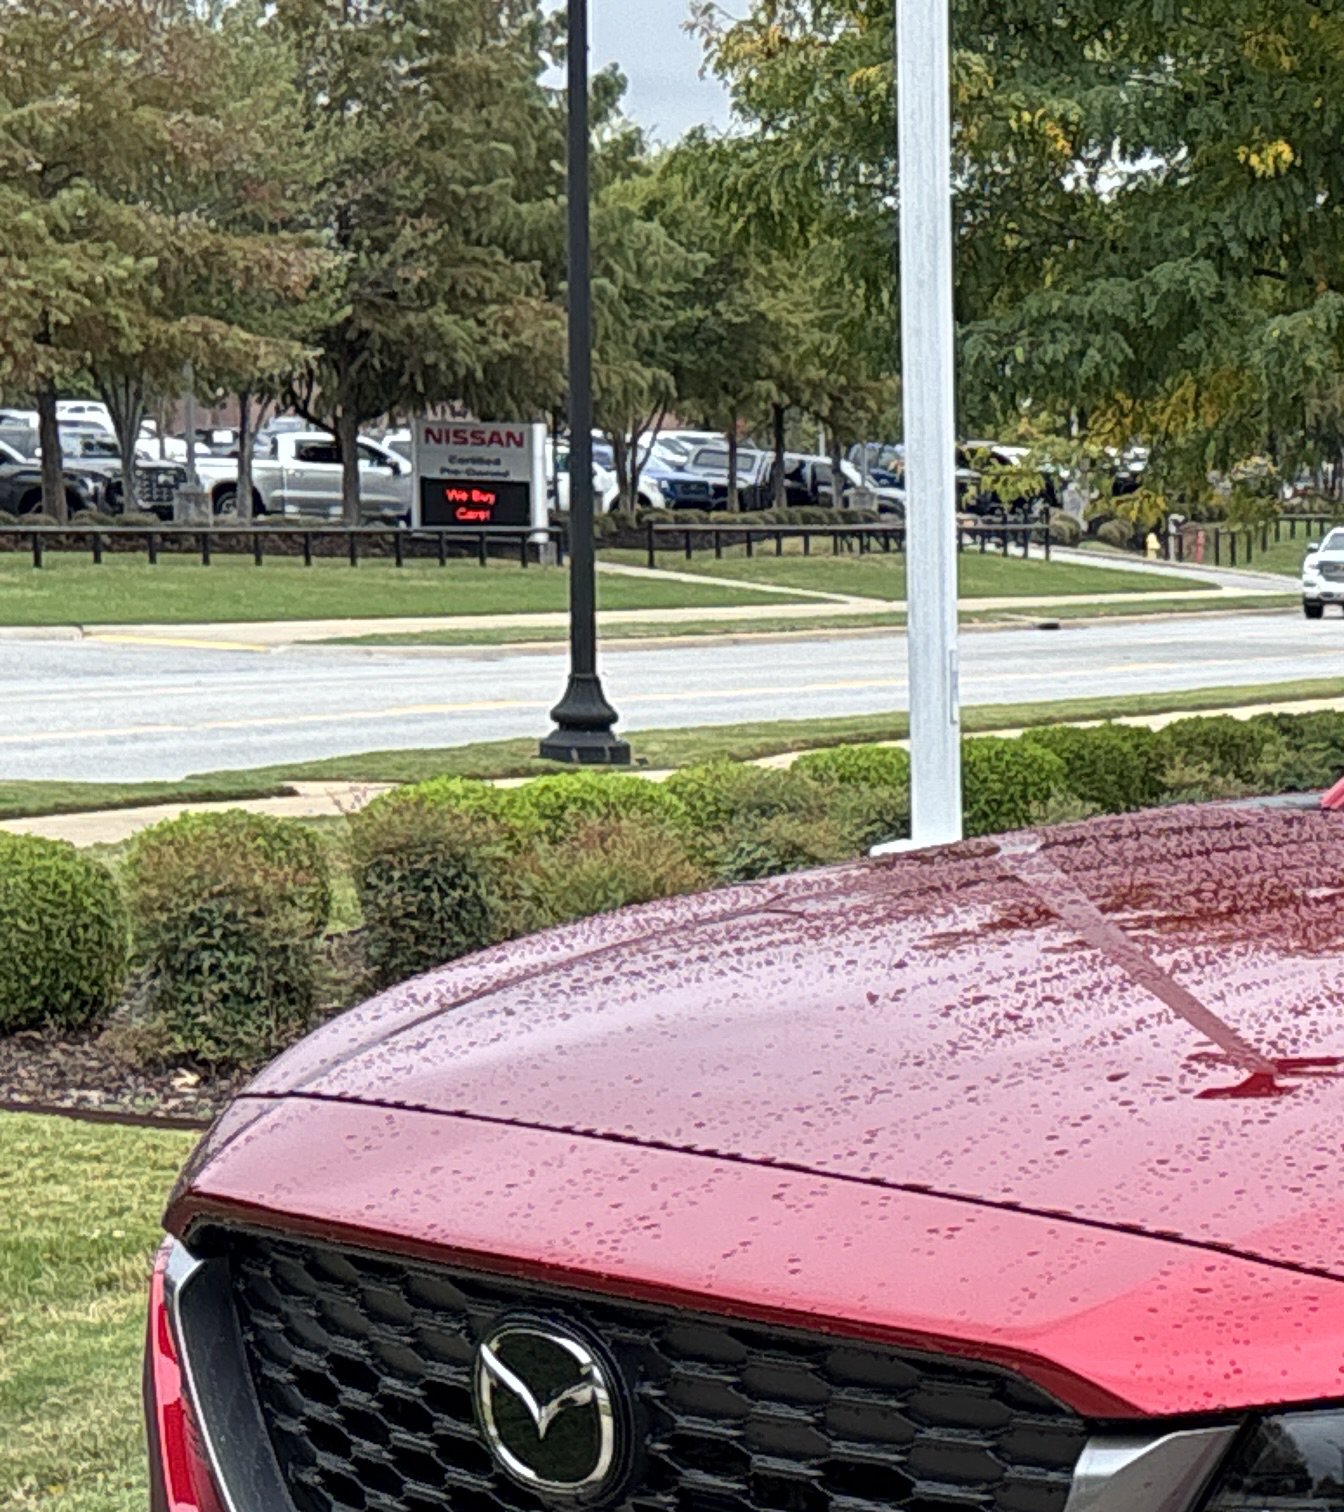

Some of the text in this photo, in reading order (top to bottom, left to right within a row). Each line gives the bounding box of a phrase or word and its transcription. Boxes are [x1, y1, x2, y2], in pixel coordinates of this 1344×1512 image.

[424, 427, 524, 448] NISSAN
[447, 454, 501, 466] Certified
[446, 488, 496, 505] We Buy
